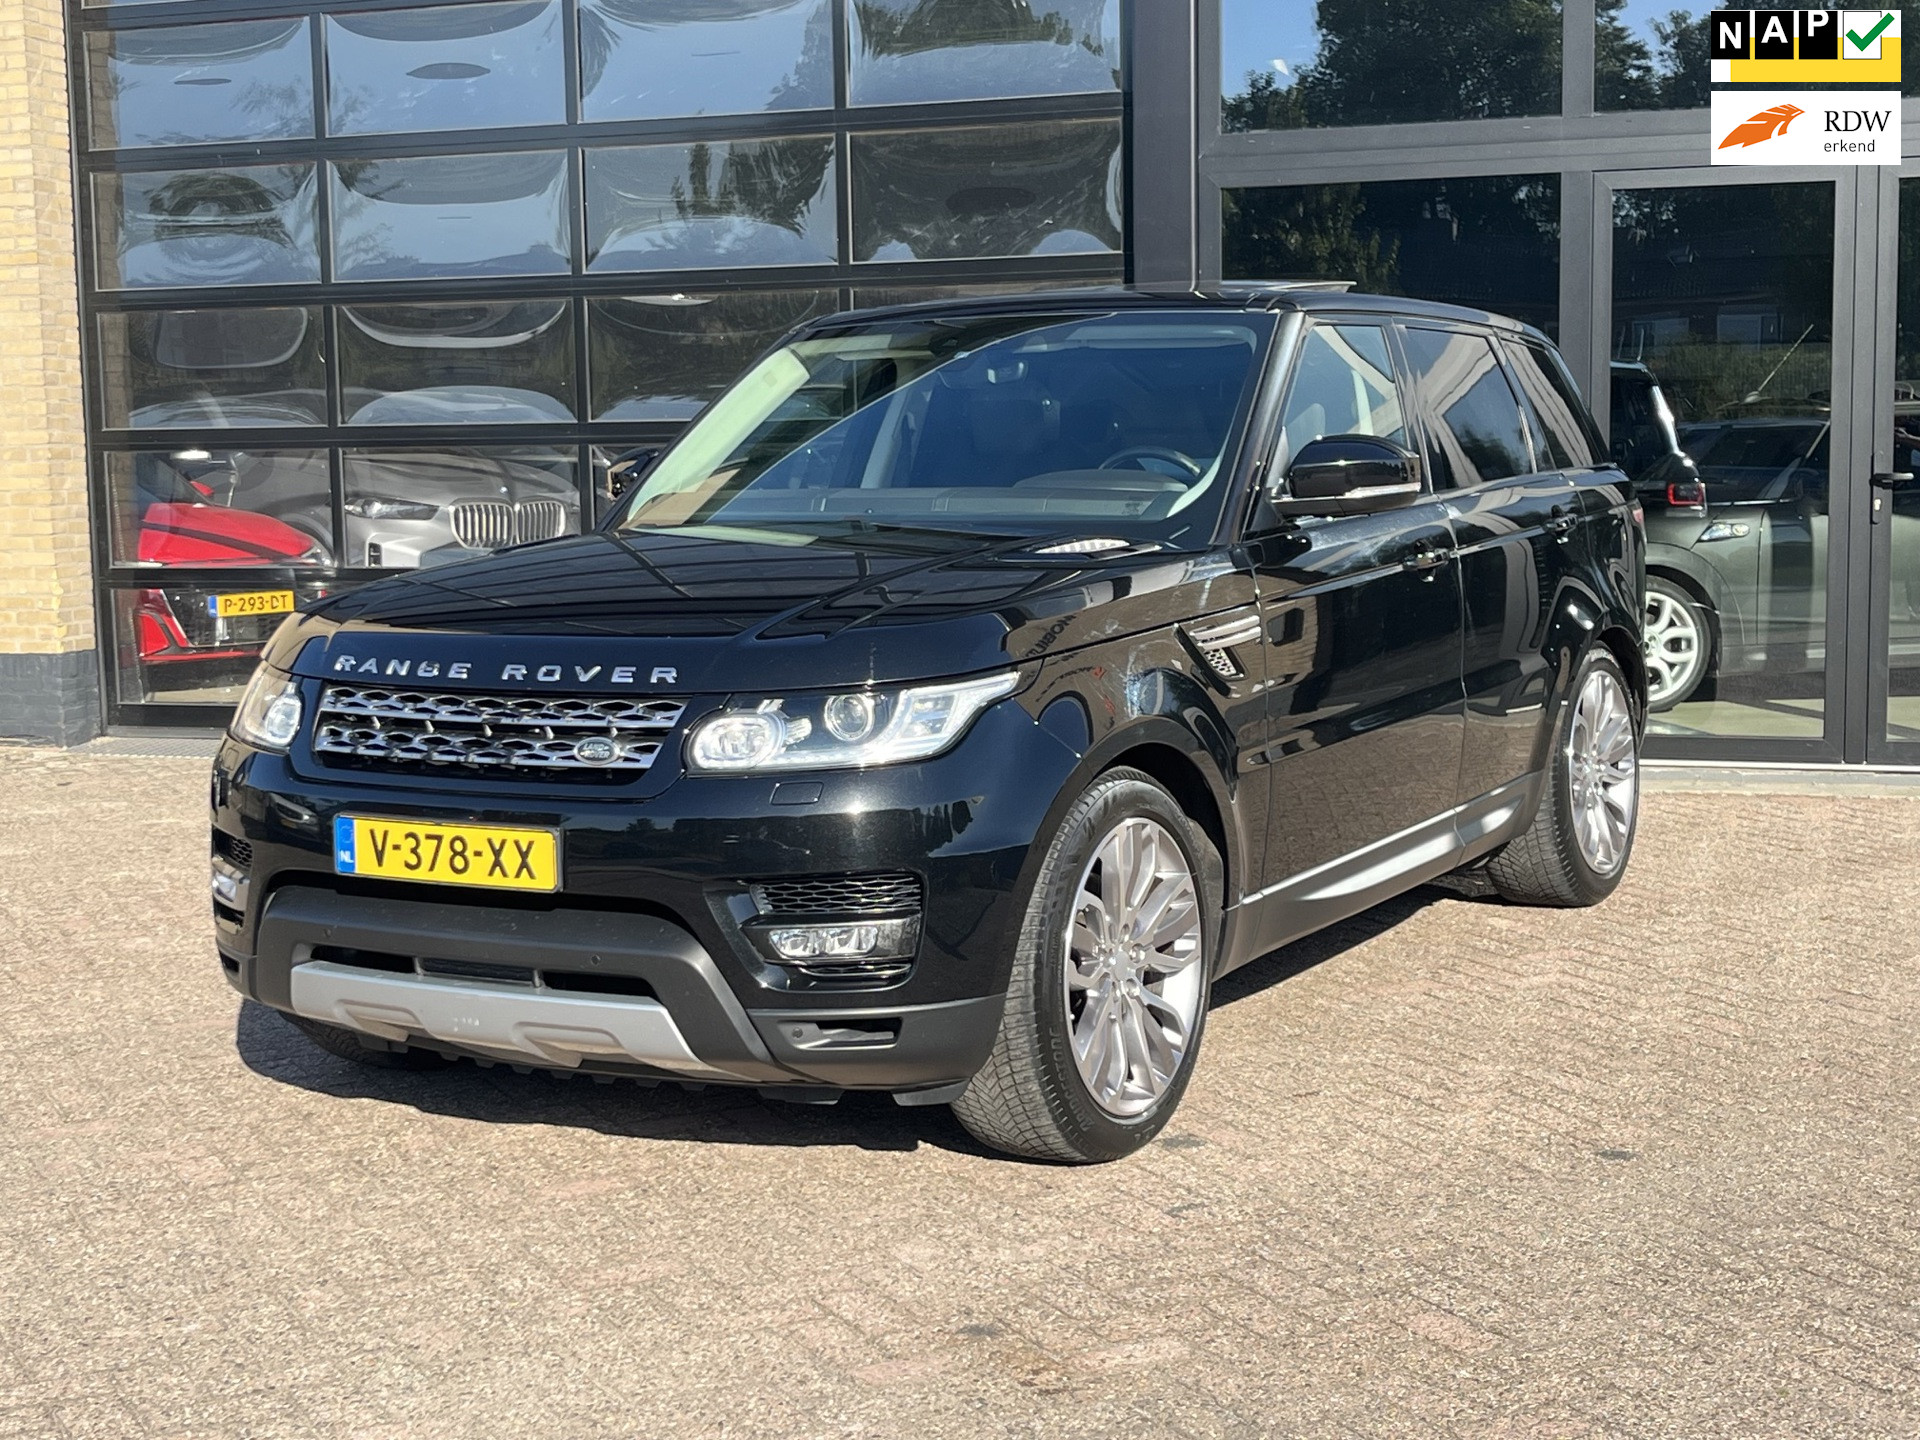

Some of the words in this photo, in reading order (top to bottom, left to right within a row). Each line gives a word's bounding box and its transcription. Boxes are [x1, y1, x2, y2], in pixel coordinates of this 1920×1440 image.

[223, 594, 288, 613] P-293-DT
[334, 655, 472, 680] RANGE
[501, 663, 678, 684] ROVER
[339, 849, 353, 864] NL
[369, 829, 536, 880] V-378-XX
